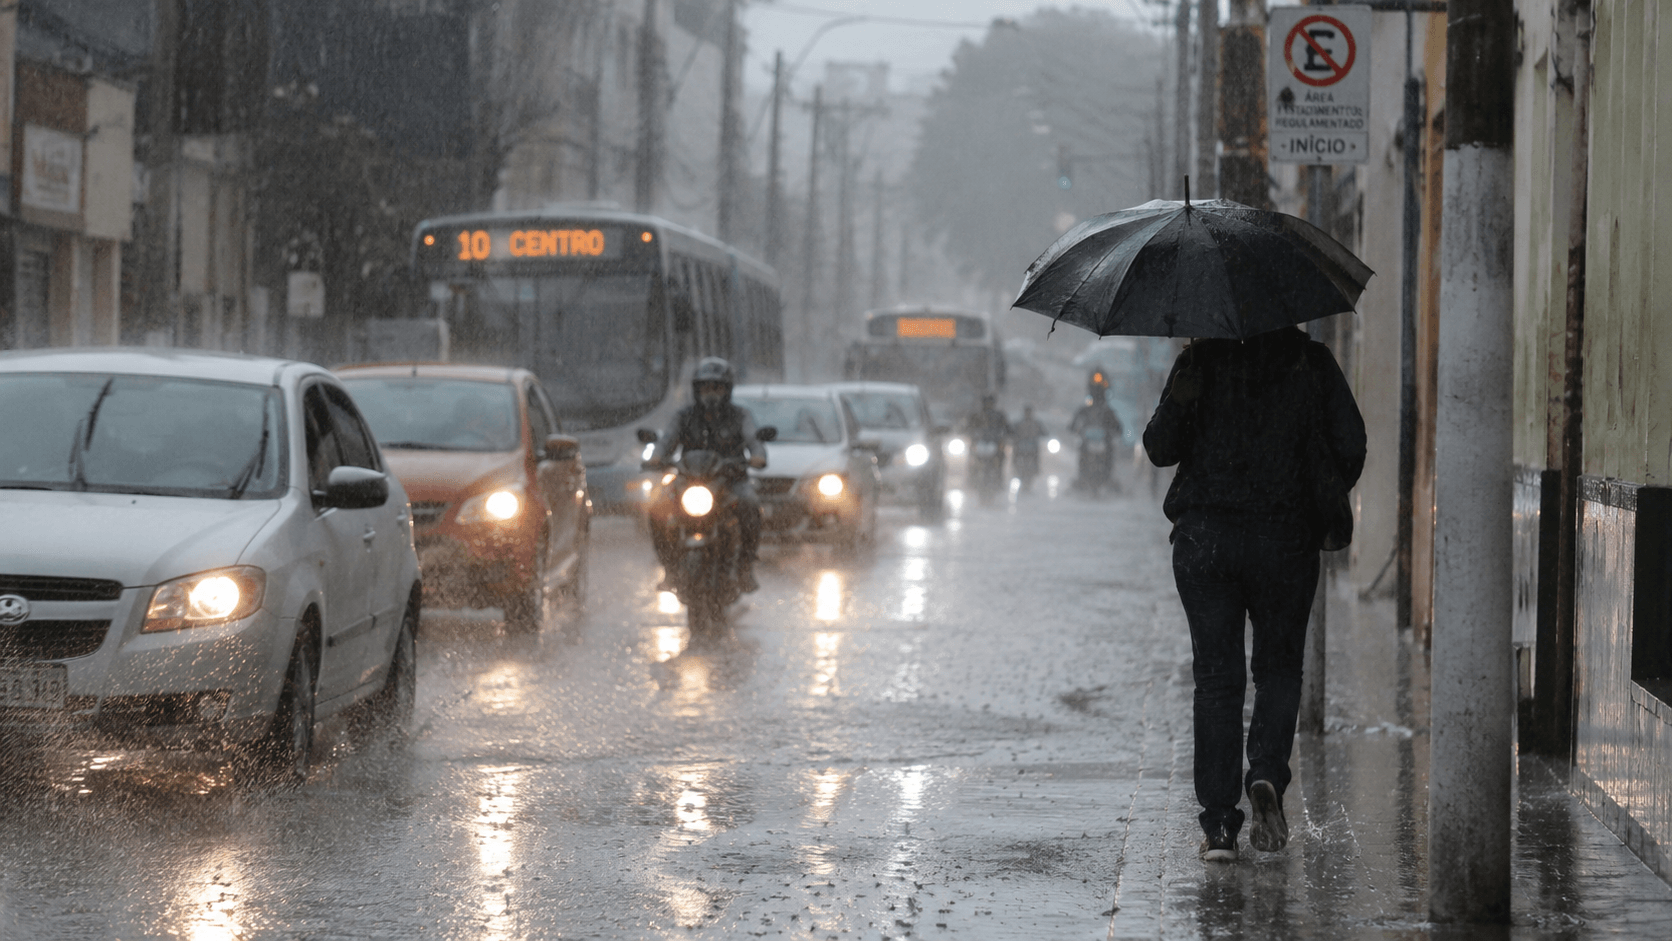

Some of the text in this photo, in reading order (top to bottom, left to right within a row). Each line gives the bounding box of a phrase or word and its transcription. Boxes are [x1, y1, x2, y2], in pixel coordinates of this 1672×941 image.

[1304, 88, 1335, 102] ÁREA
[1290, 134, 1346, 154] INÍCIO
[457, 229, 605, 260] 10 CENTRO
